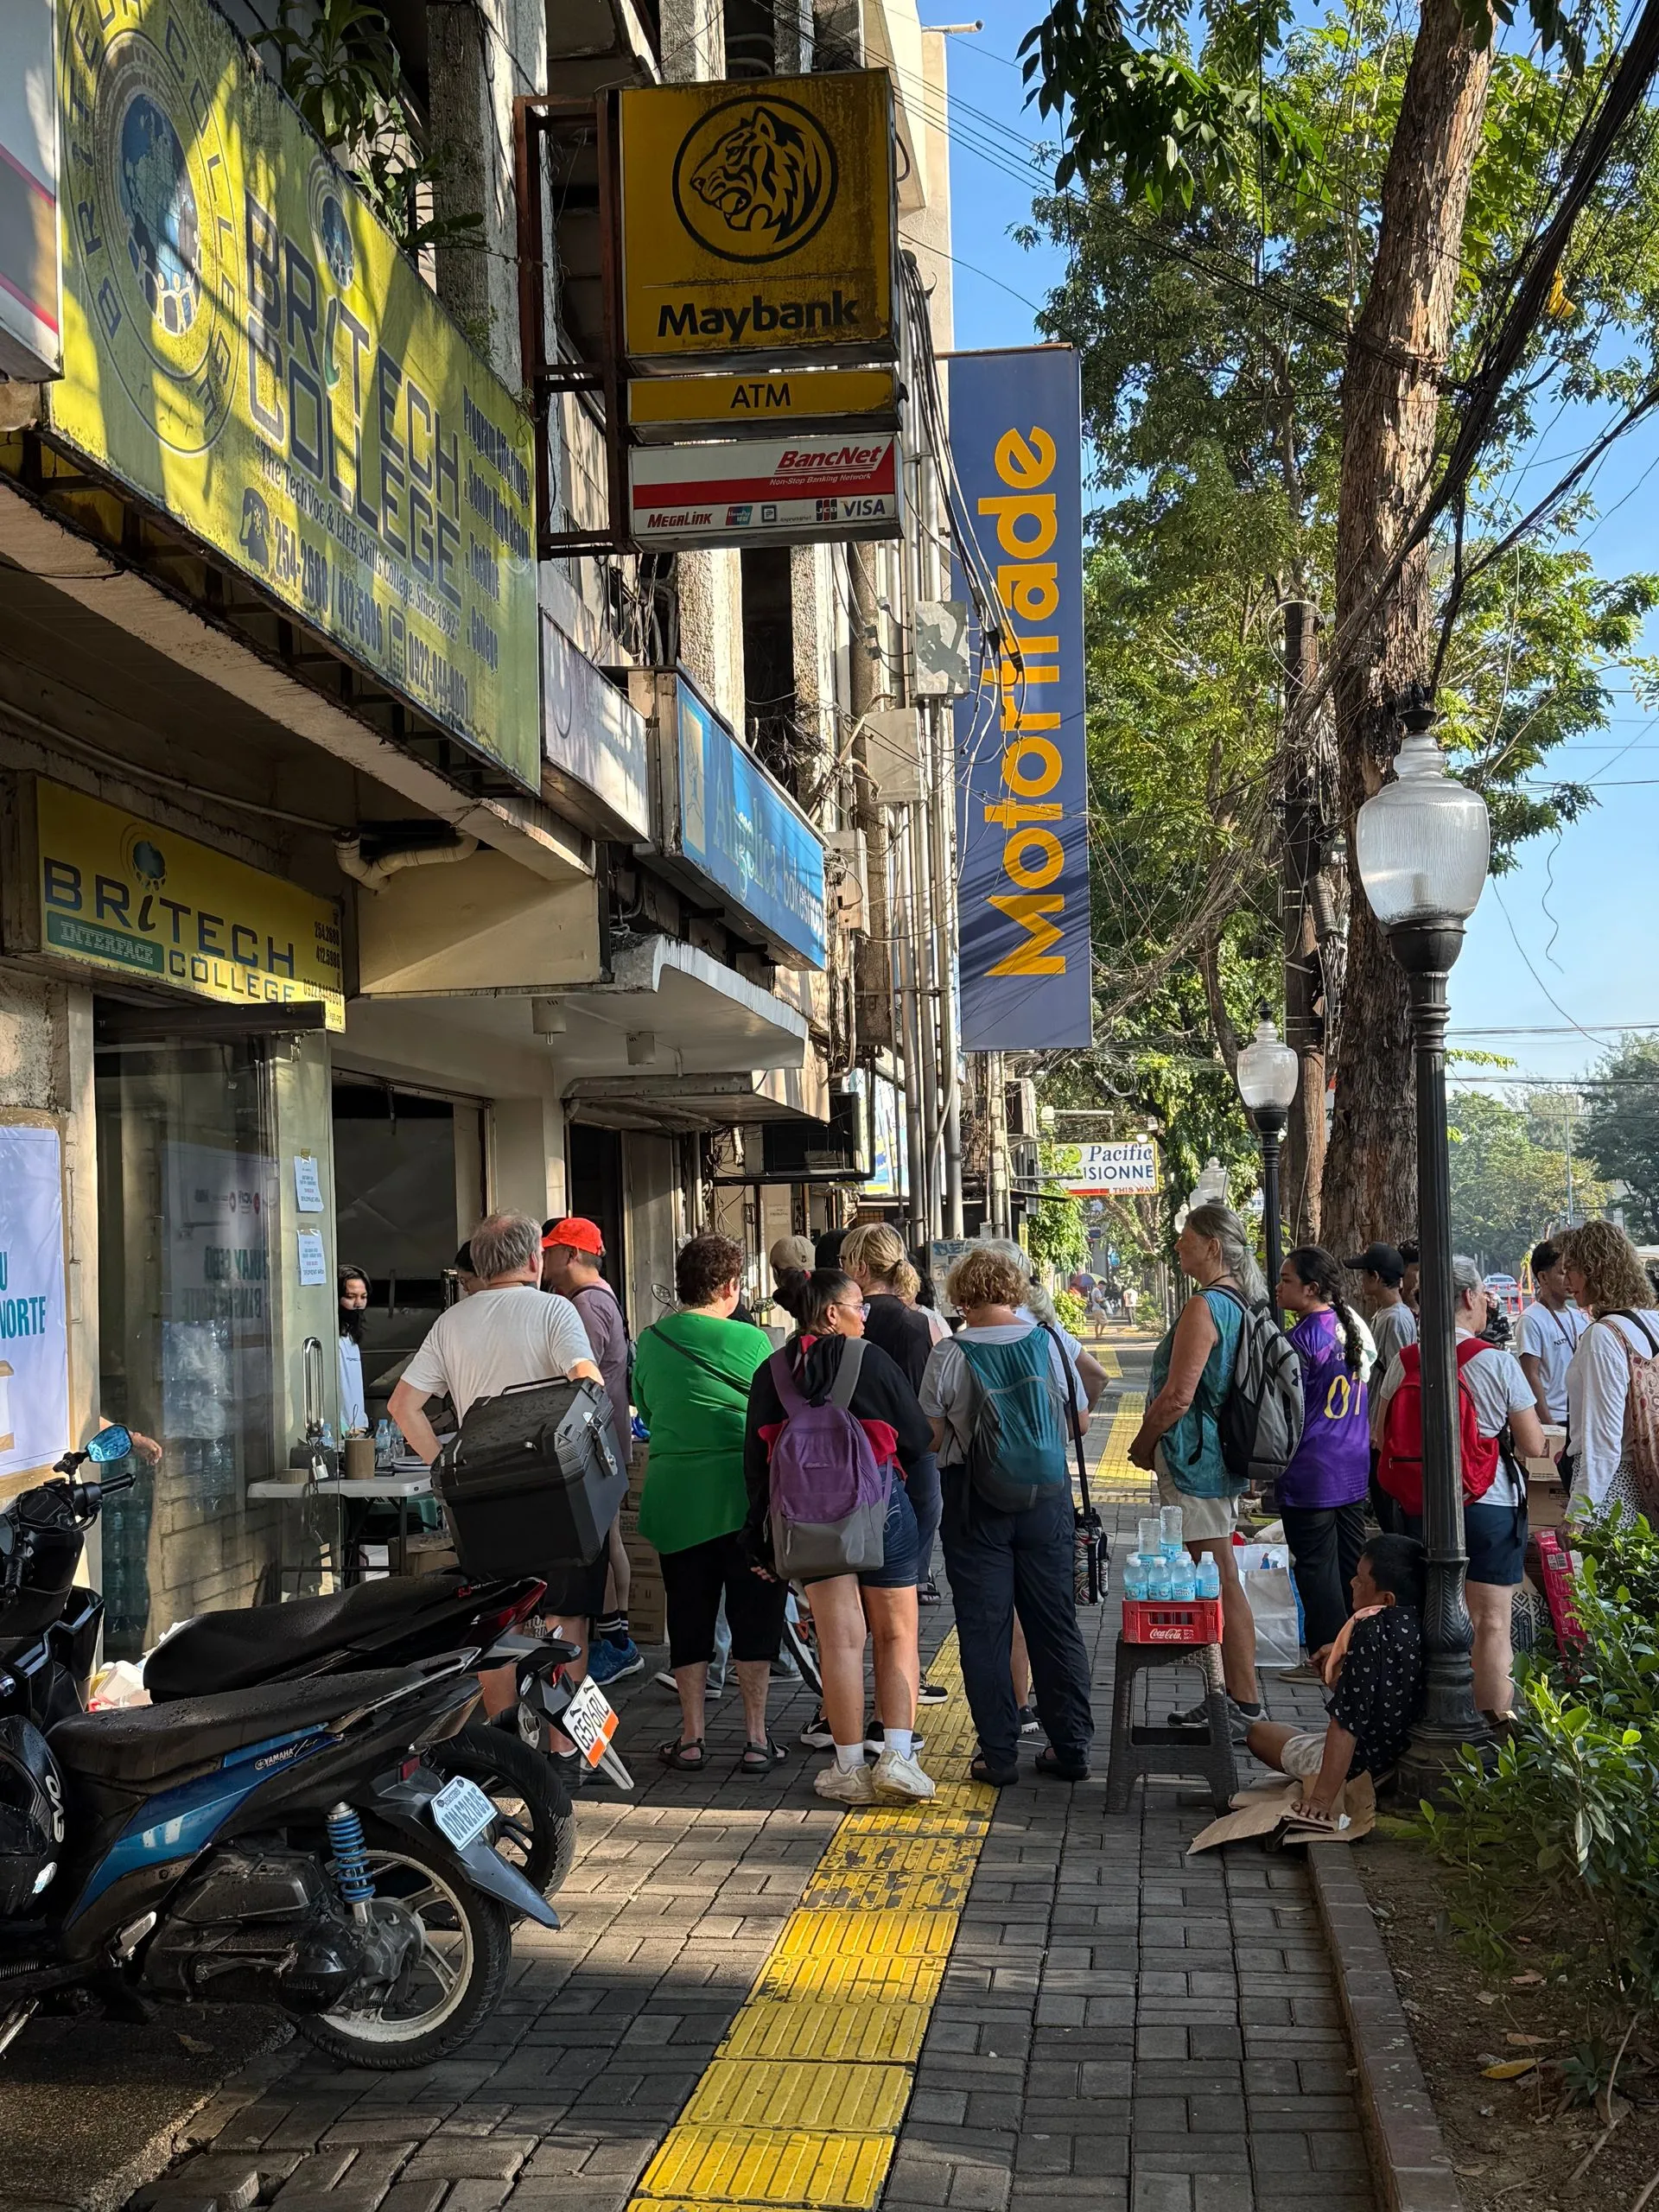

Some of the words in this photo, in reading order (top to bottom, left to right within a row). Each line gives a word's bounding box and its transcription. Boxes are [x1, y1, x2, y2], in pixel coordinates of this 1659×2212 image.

[657, 290, 860, 341] Maybank
[730, 383, 791, 410] ATM
[247, 308, 462, 608] COLLEGE
[769, 477, 805, 486] Non-Stop
[806, 475, 837, 485] Banking
[840, 473, 871, 481] Network
[778, 446, 882, 469] BancNet
[842, 499, 886, 517] VISA
[327, 503, 334, 535] &
[336, 512, 358, 554] LIFE
[359, 531, 382, 577] Skills
[416, 580, 436, 625] Since
[977, 424, 1067, 979] Motortrade
[60, 920, 154, 965] INTERFACE
[169, 950, 296, 1002] COLLEGE
[1088, 1143, 1153, 1162] Pacific
[1136, 1185, 1155, 1193] WAY
[573, 1692, 610, 1751] G596RL
[265, 1747, 295, 1768] YAMAHA
[45, 1775, 65, 1843] EVO
